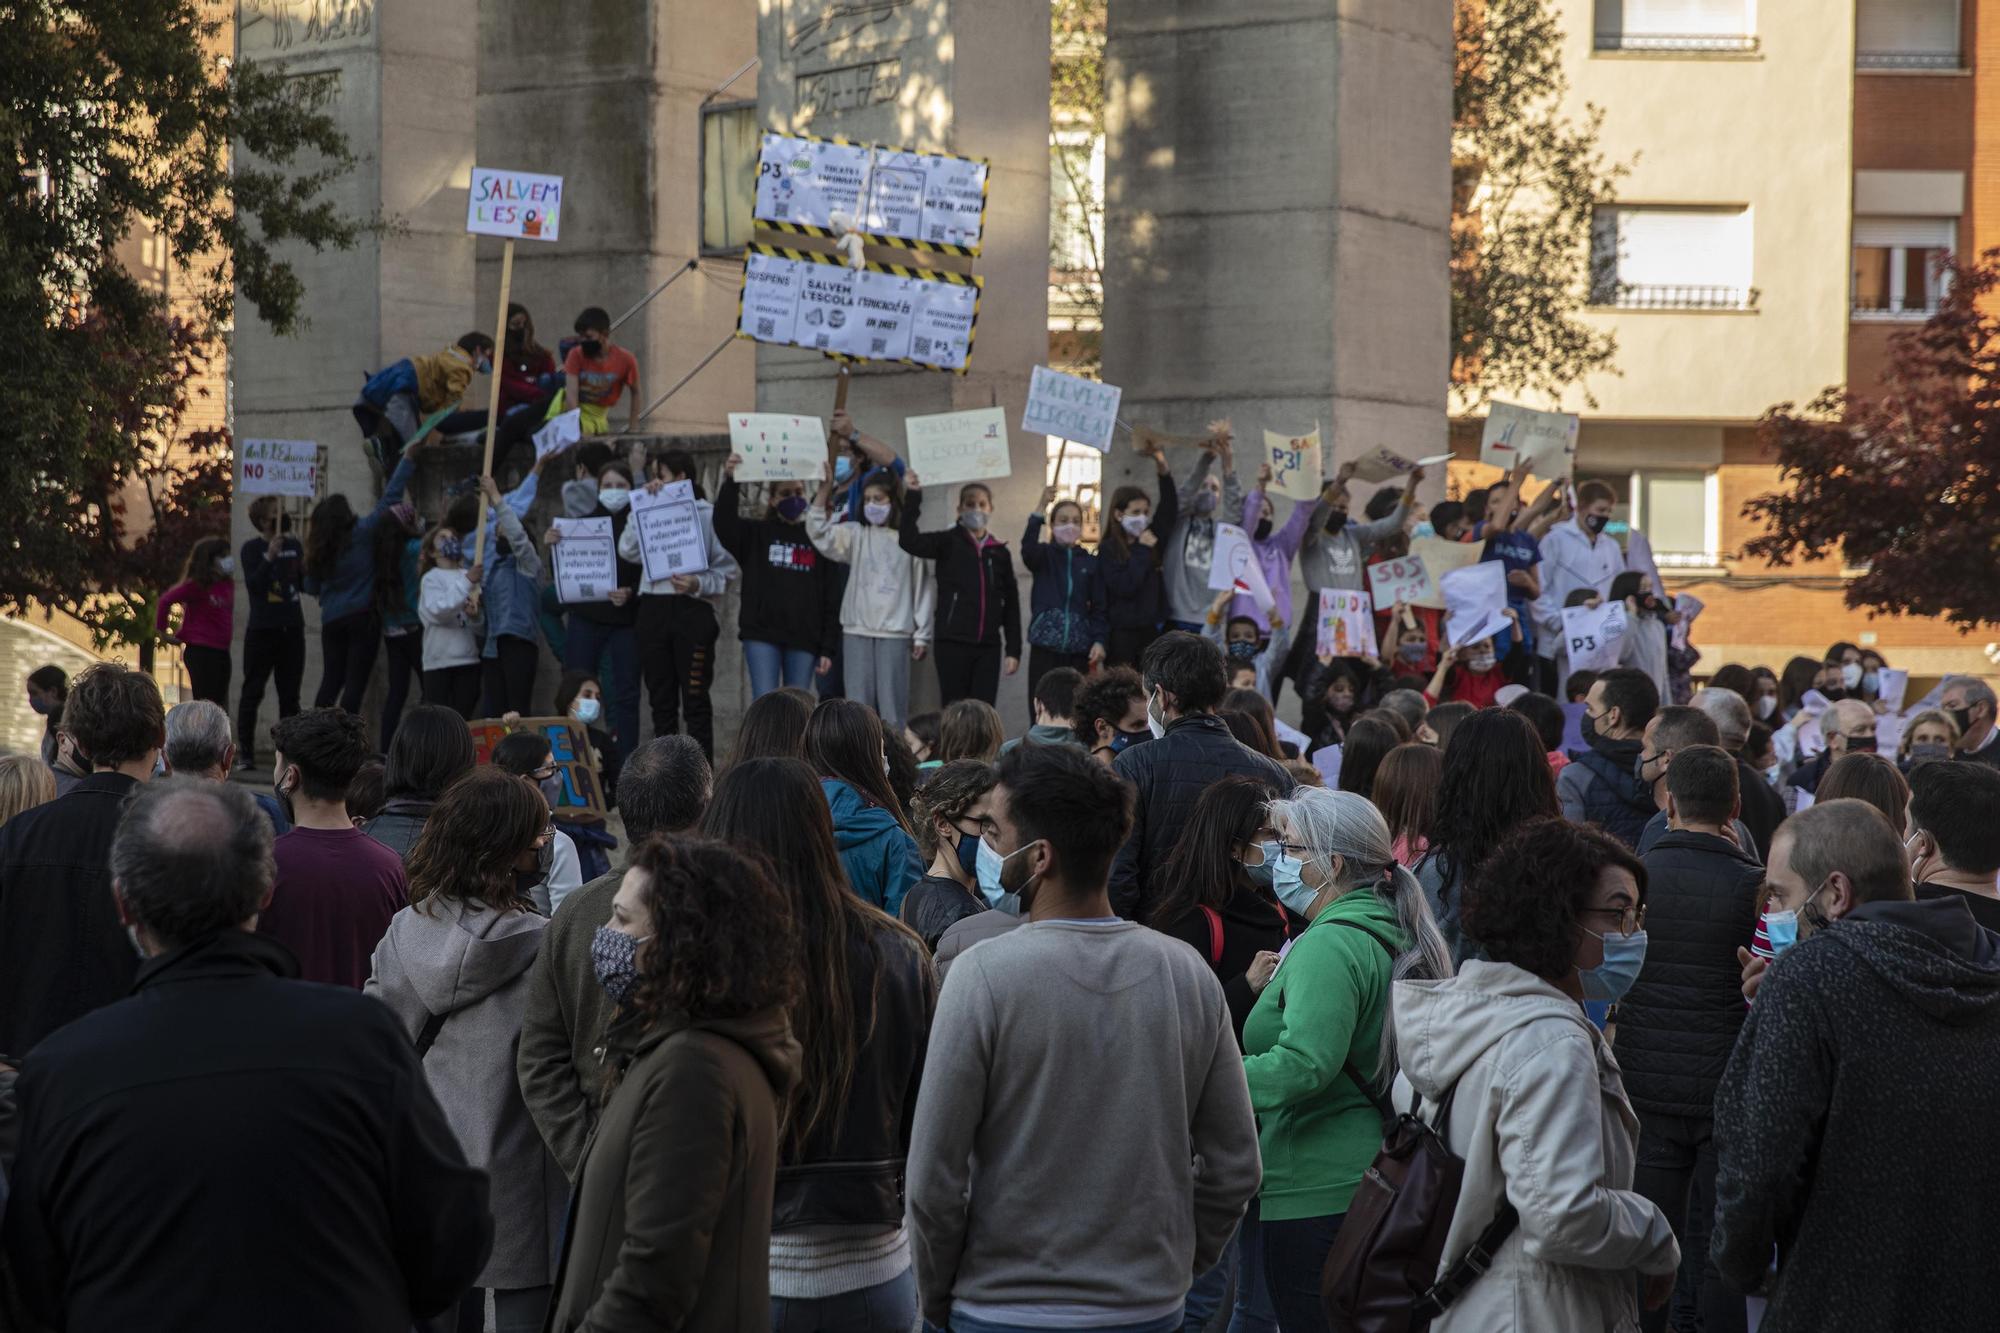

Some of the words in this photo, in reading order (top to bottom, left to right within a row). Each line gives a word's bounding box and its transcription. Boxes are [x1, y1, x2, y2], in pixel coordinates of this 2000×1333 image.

[761, 162, 782, 178] P3
[475, 175, 559, 203] SALVEM
[807, 279, 852, 294] SALVEM
[801, 290, 853, 307] L'ESCOLA
[1036, 375, 1112, 411] SALVEM
[1272, 448, 1301, 471] P3!
[244, 463, 264, 479] NO
[1376, 554, 1422, 583] SOS
[1572, 635, 1595, 653] P3
